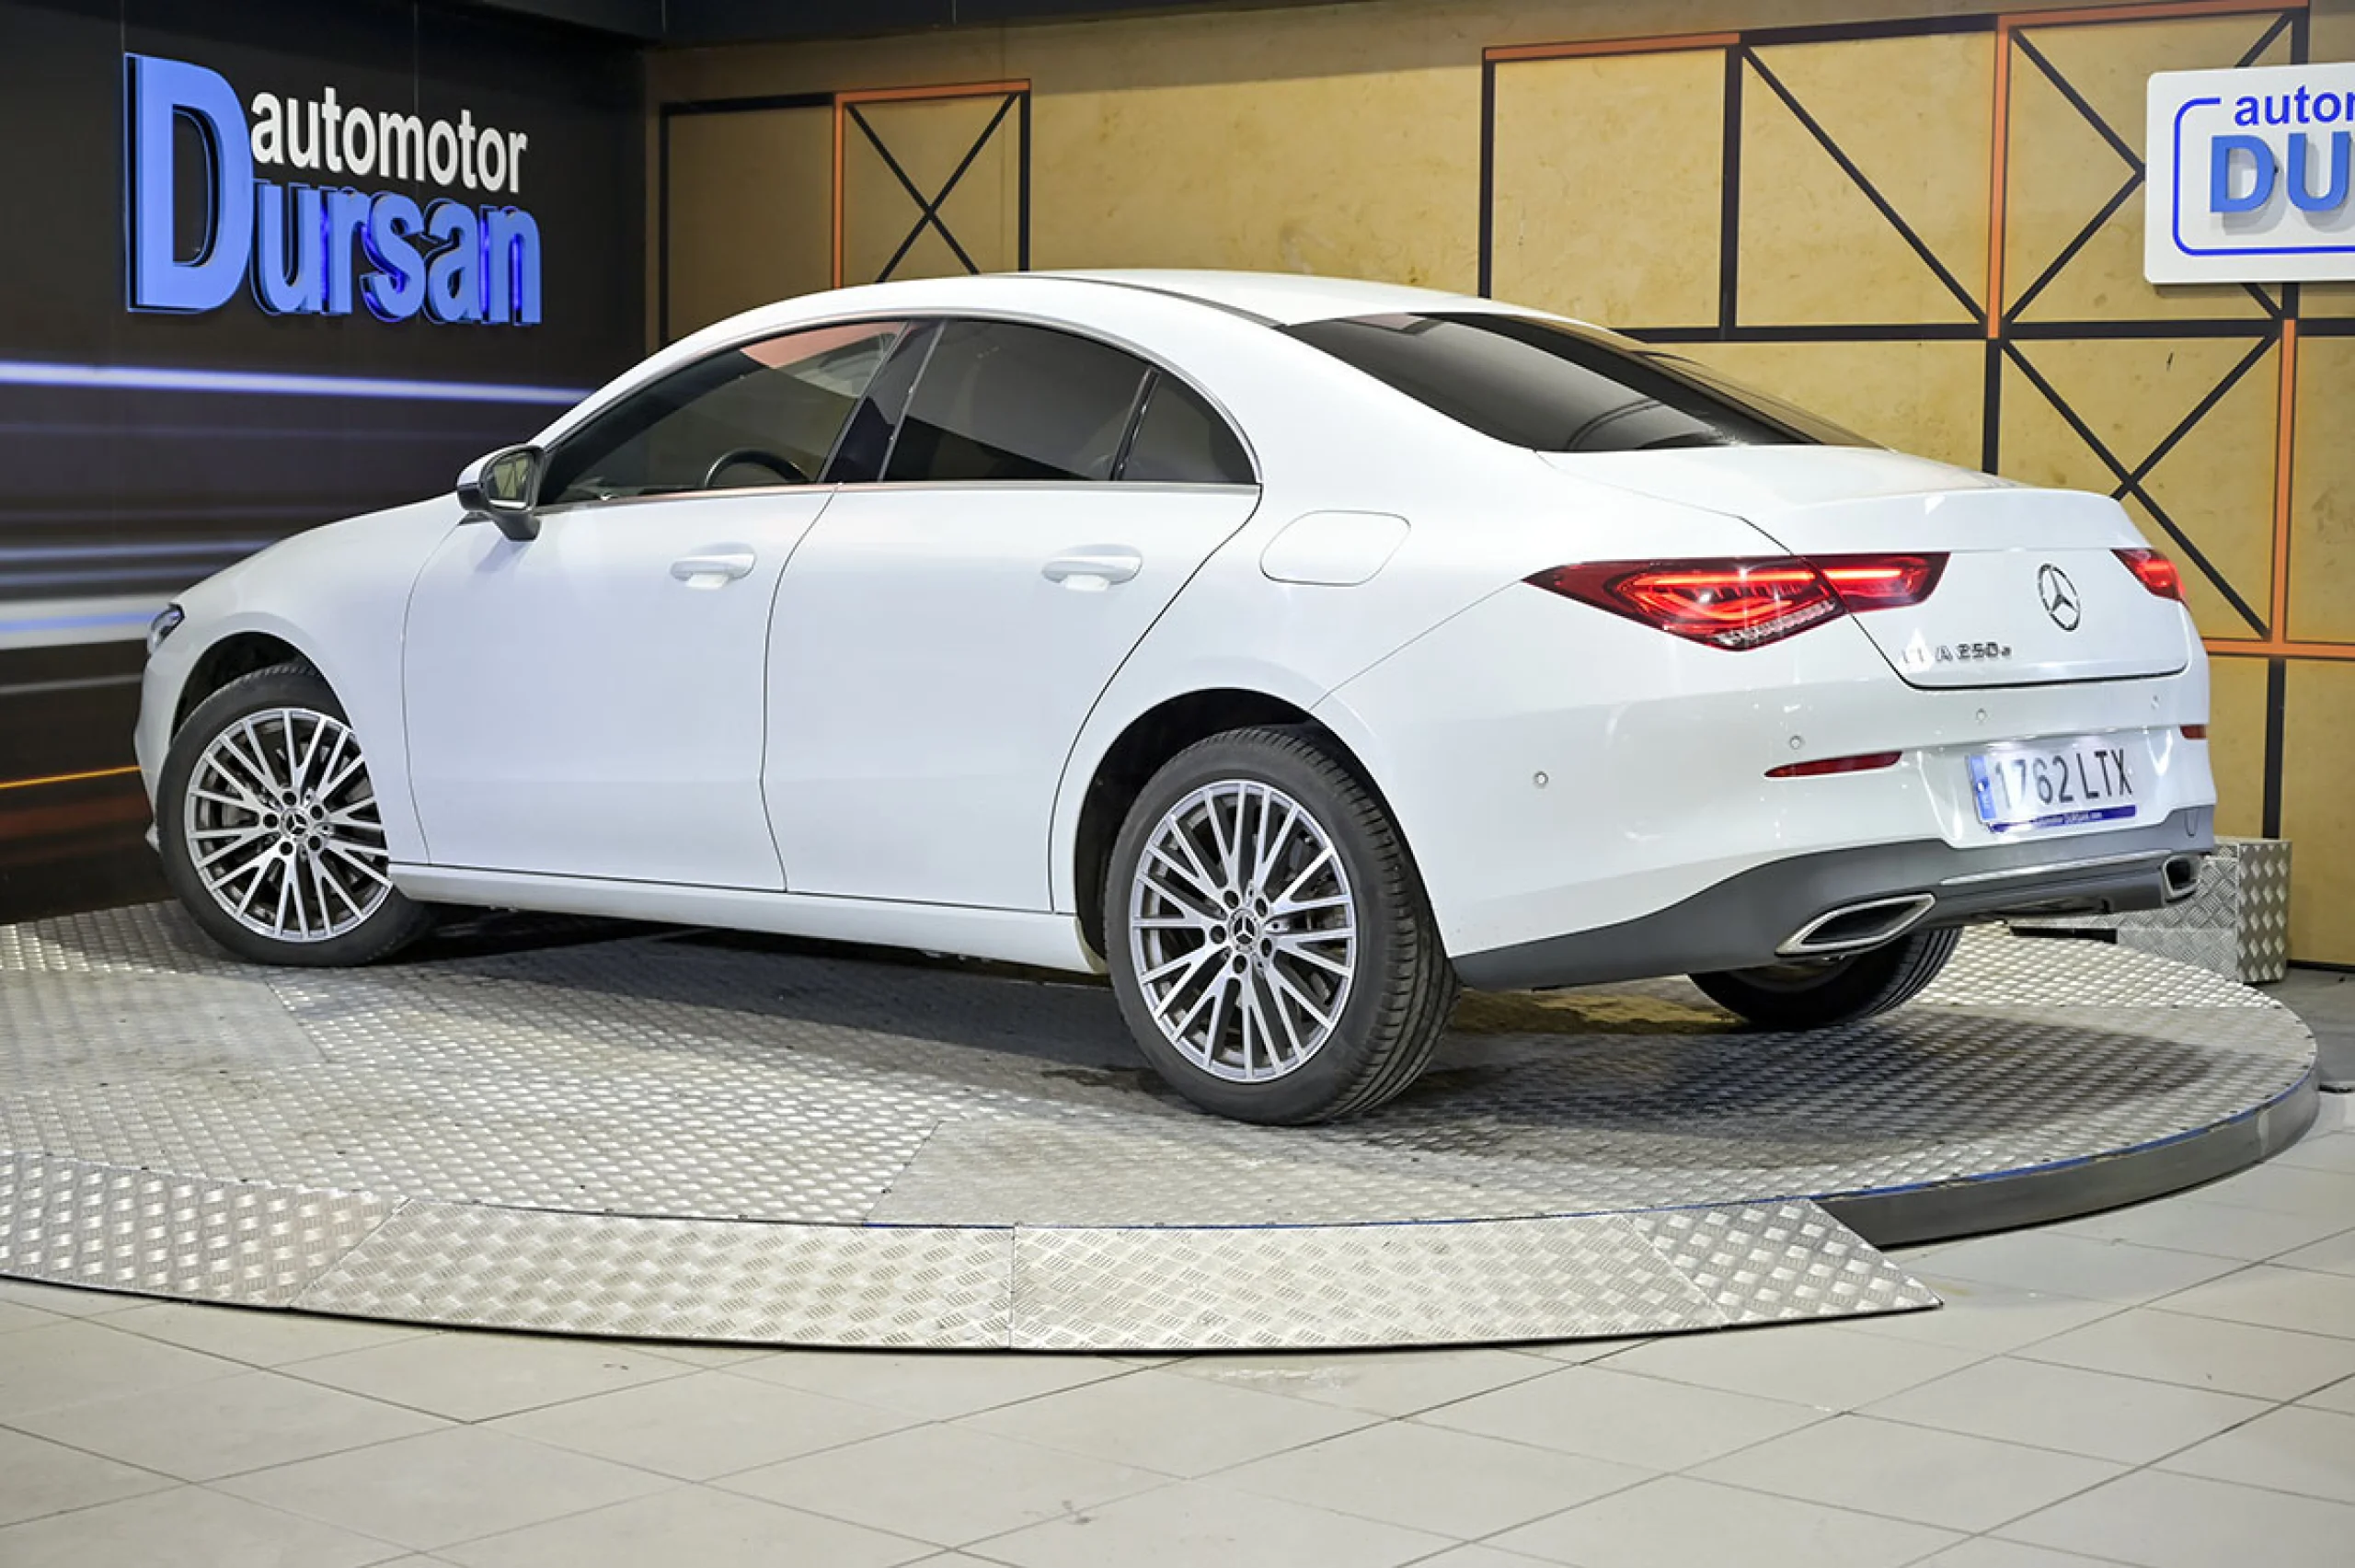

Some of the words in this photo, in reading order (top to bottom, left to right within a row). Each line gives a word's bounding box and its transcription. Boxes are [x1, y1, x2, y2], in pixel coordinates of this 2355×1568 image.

[250, 86, 529, 193] automotor
[2210, 132, 2351, 212] DU
[124, 52, 543, 326] Dursan
[1994, 754, 2074, 809] 1762
[2076, 748, 2132, 800] LTX
